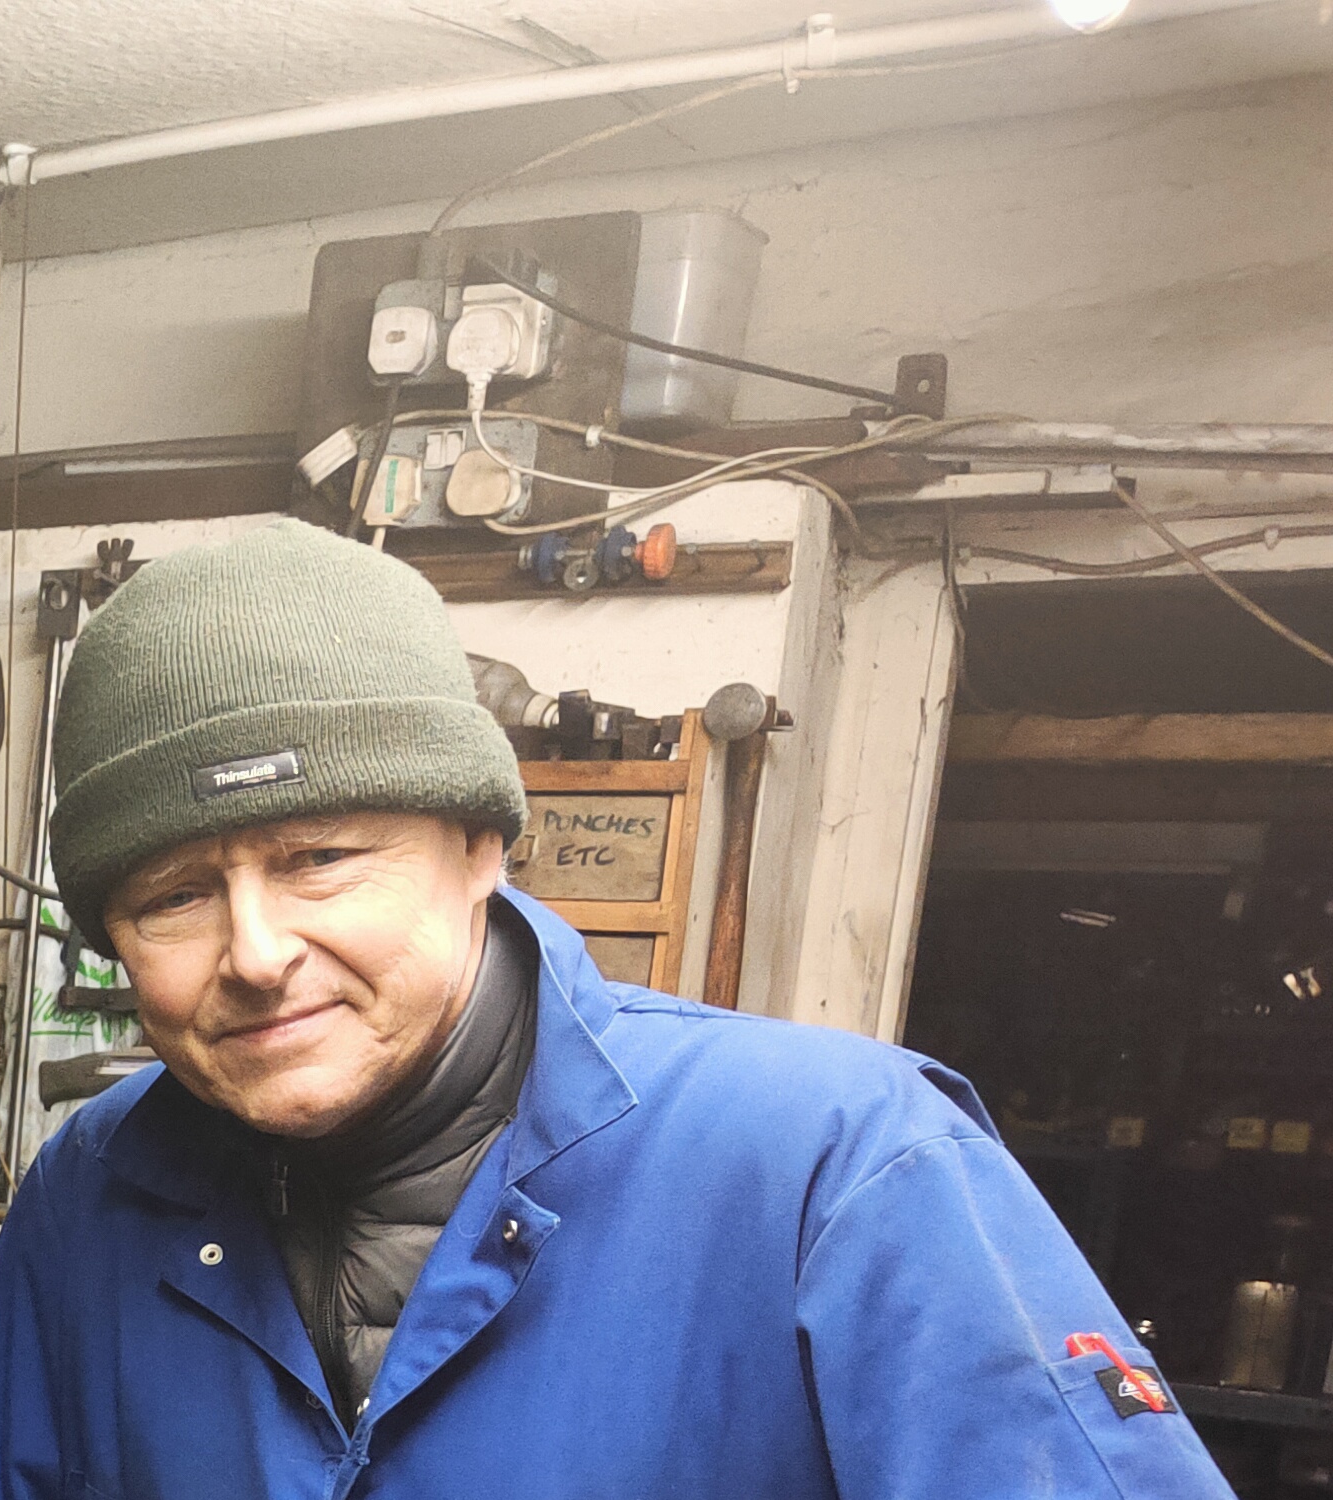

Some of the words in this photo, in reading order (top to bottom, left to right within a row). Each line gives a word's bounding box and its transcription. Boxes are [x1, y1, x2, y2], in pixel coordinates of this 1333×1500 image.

[213, 762, 277, 787] Thinsulate
[543, 808, 656, 839] PUNCHES
[556, 843, 616, 867] ETC
